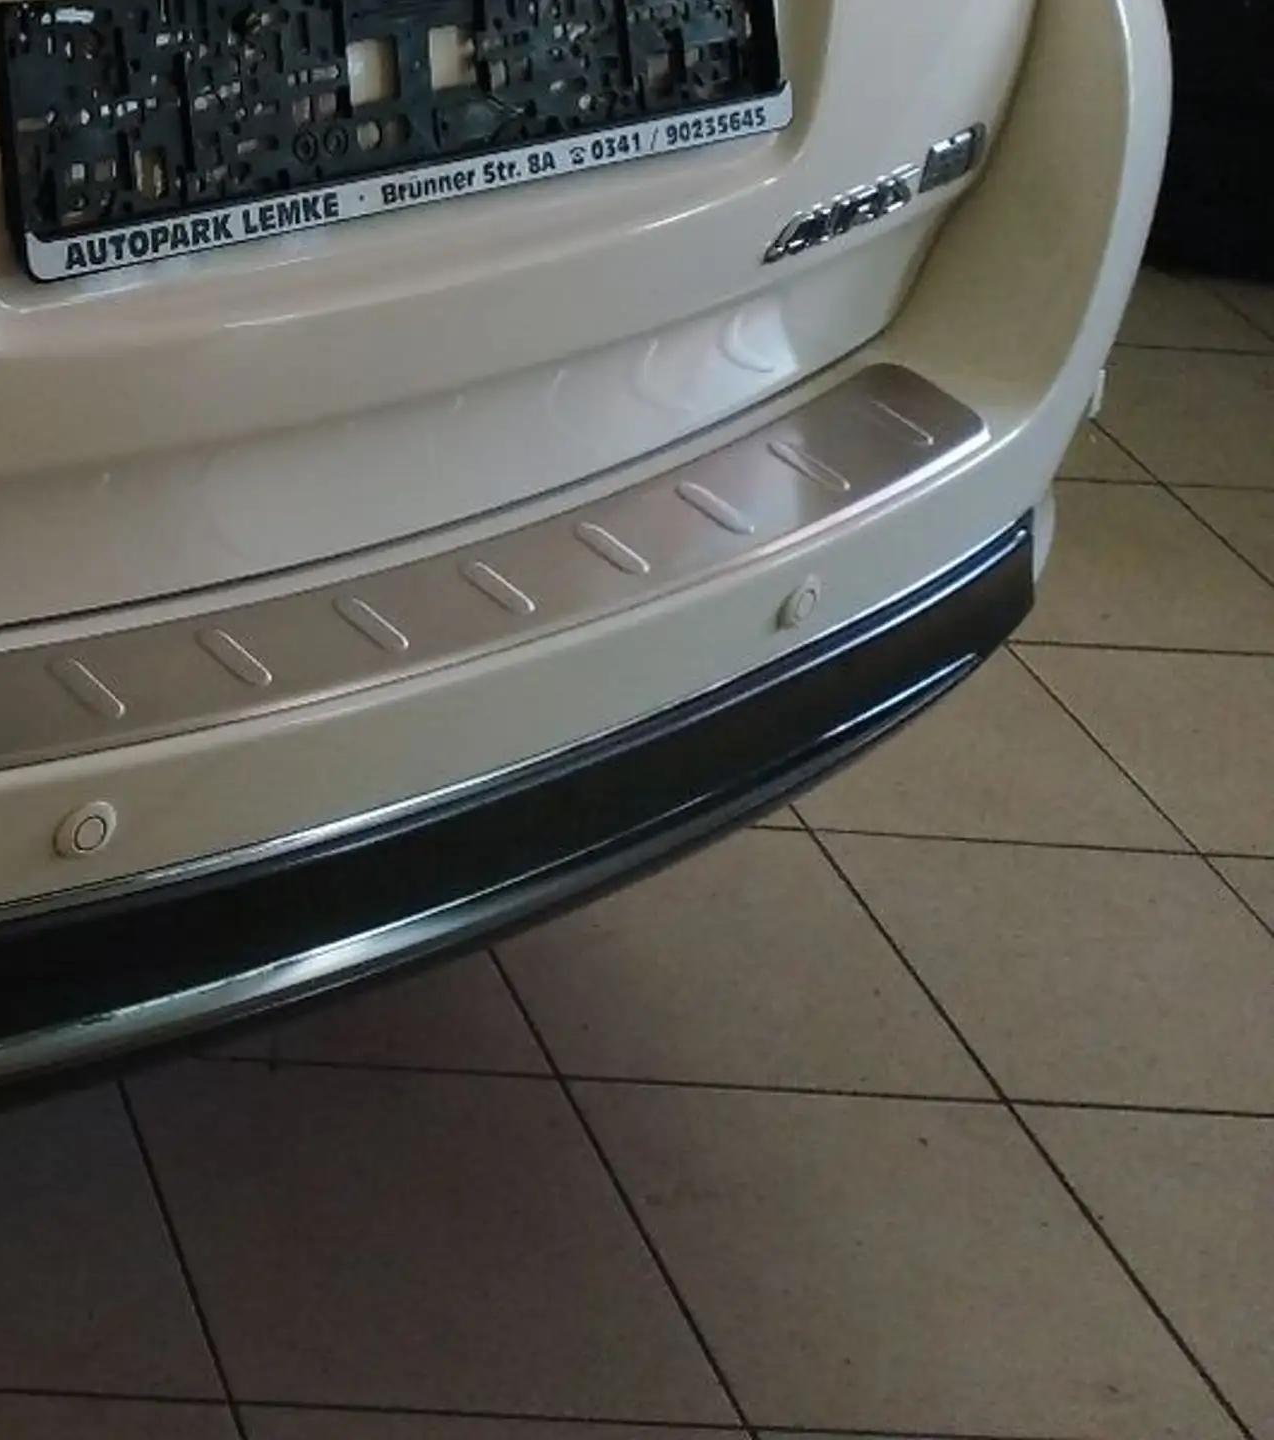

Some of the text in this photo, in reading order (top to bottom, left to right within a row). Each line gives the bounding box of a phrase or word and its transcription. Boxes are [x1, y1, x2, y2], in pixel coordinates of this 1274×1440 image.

[64, 213, 234, 270] AUTOPARK
[241, 192, 339, 234] LEMKE
[483, 160, 521, 184] Str.
[529, 151, 556, 174] 8A
[591, 132, 641, 160] 0341
